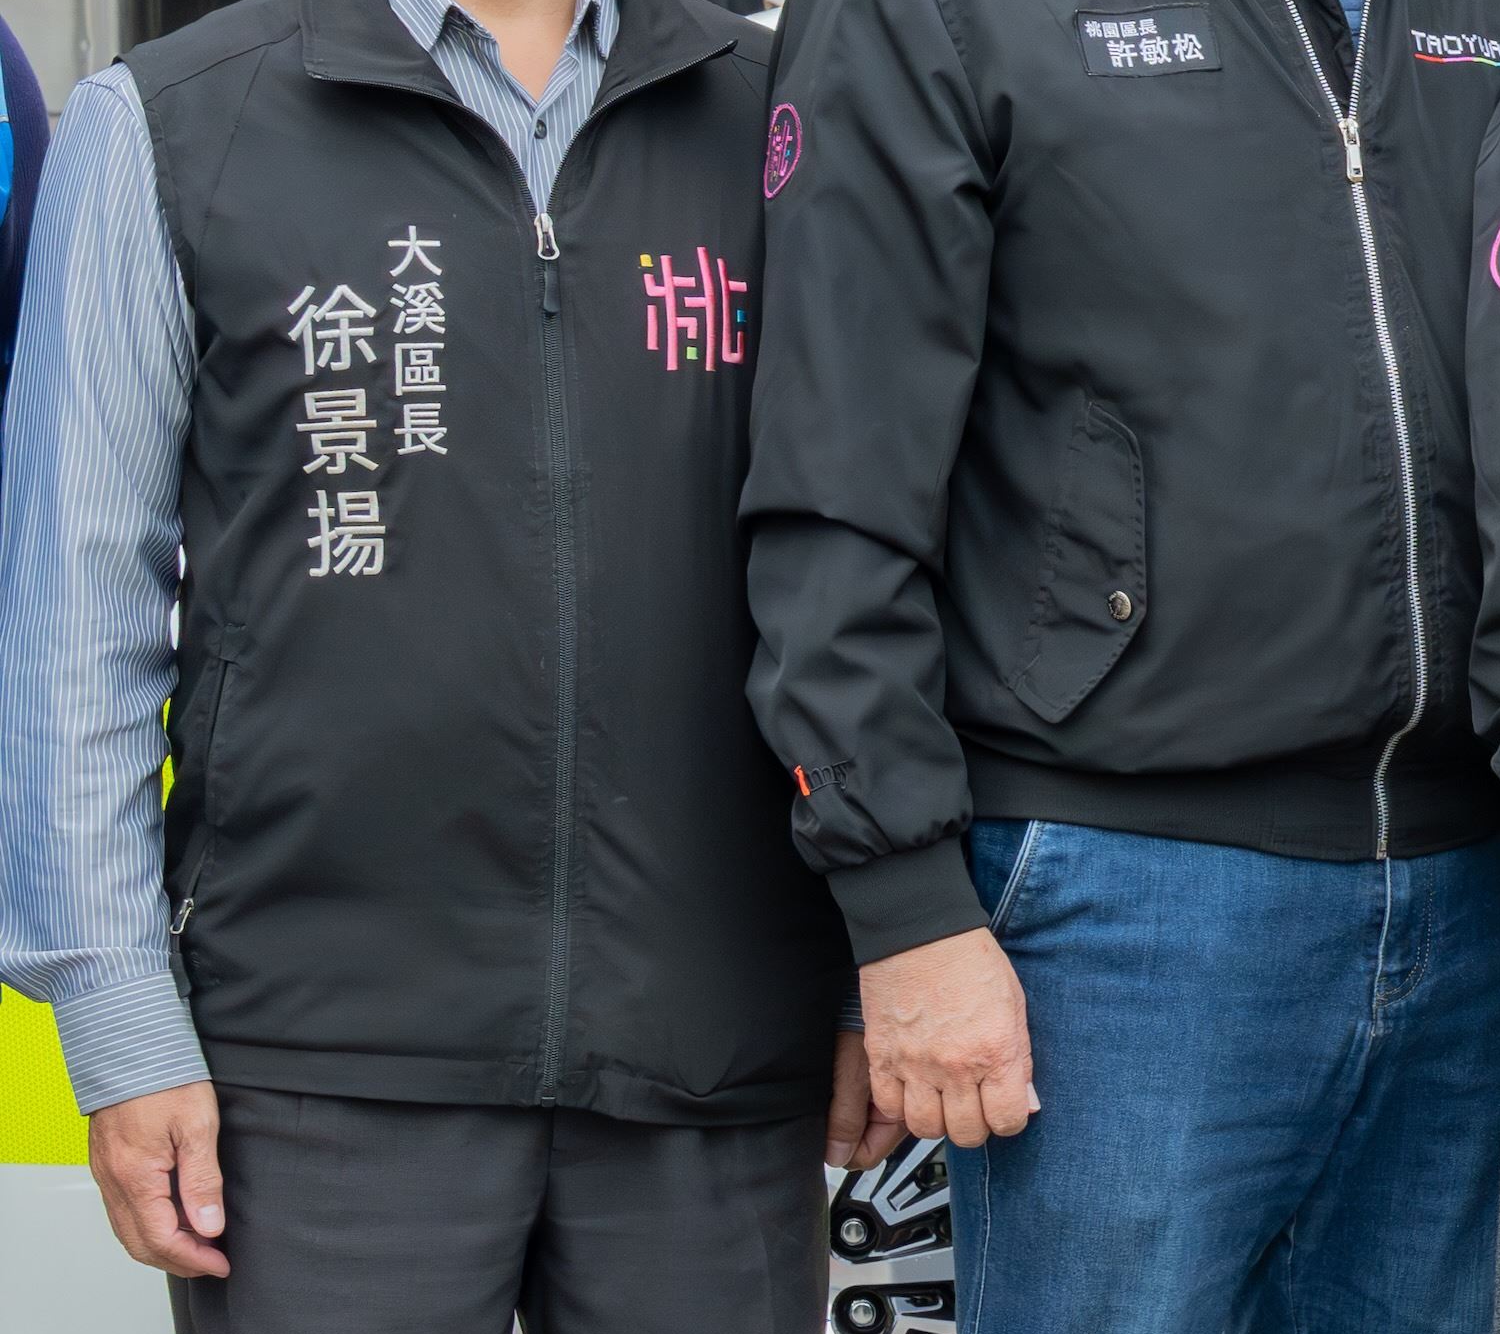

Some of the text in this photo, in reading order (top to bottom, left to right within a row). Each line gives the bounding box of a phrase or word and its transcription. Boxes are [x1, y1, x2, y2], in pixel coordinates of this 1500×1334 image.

[1084, 18, 1159, 39] 桃園區長
[1106, 32, 1205, 68] 許敏松
[387, 224, 449, 456] 大溪區長
[285, 282, 388, 578] 徐景揚
